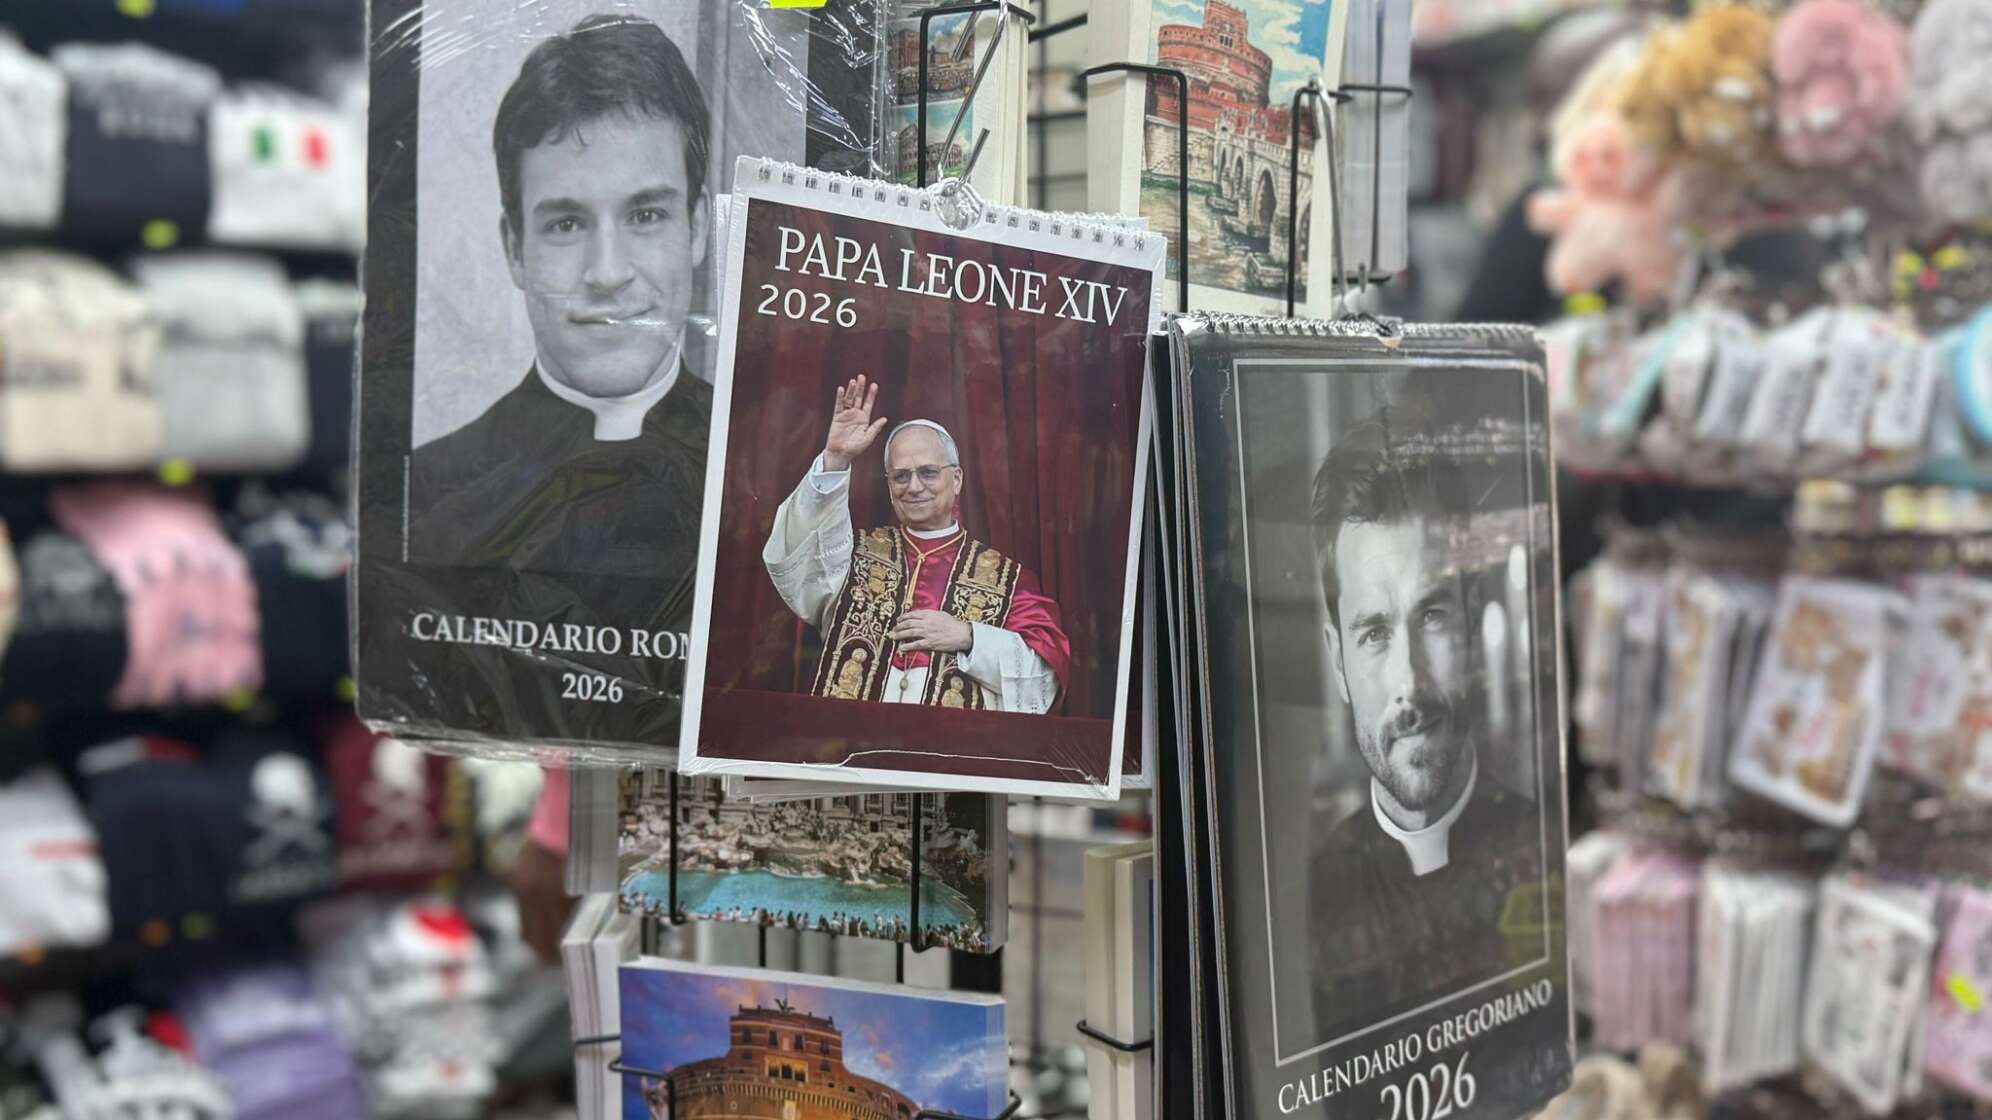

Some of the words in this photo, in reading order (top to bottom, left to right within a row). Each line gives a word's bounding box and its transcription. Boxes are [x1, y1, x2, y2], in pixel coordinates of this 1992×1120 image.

[776, 226, 888, 288] PAPA
[898, 249, 1047, 315] LEONE
[1055, 276, 1128, 326] XIV
[758, 284, 857, 328] 2026
[412, 612, 621, 655] CALENDARIO
[562, 673, 623, 703] 2026
[1278, 1033, 1421, 1114] CALENDARIO
[1426, 979, 1552, 1052] GREGORIANO
[1380, 1052, 1476, 1120] 2026
